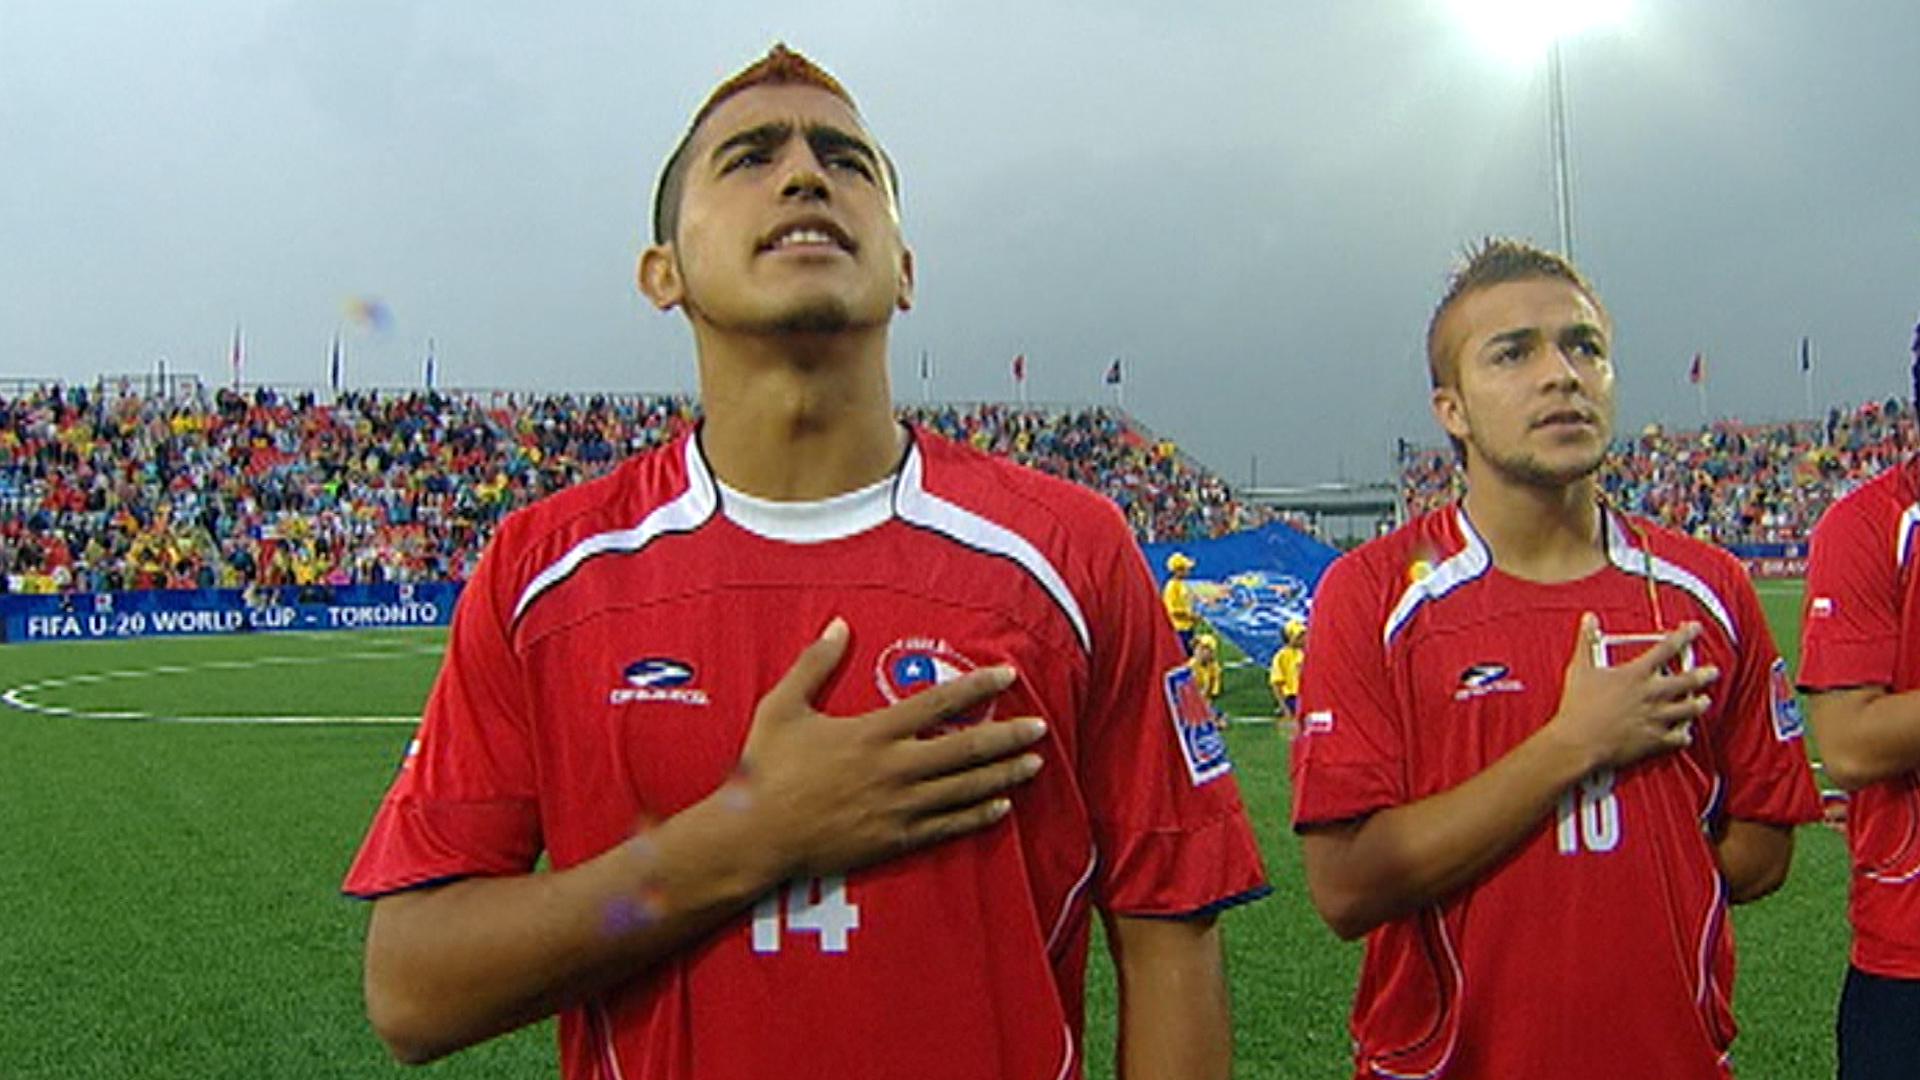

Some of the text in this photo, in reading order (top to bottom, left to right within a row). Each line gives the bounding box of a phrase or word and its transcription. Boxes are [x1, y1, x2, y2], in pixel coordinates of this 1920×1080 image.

[28, 614, 82, 637] FIFA
[88, 611, 146, 636] U-20
[151, 608, 243, 632] WORLD
[250, 604, 296, 628] CUP
[327, 601, 438, 627] TORONTO
[751, 872, 861, 953] 14
